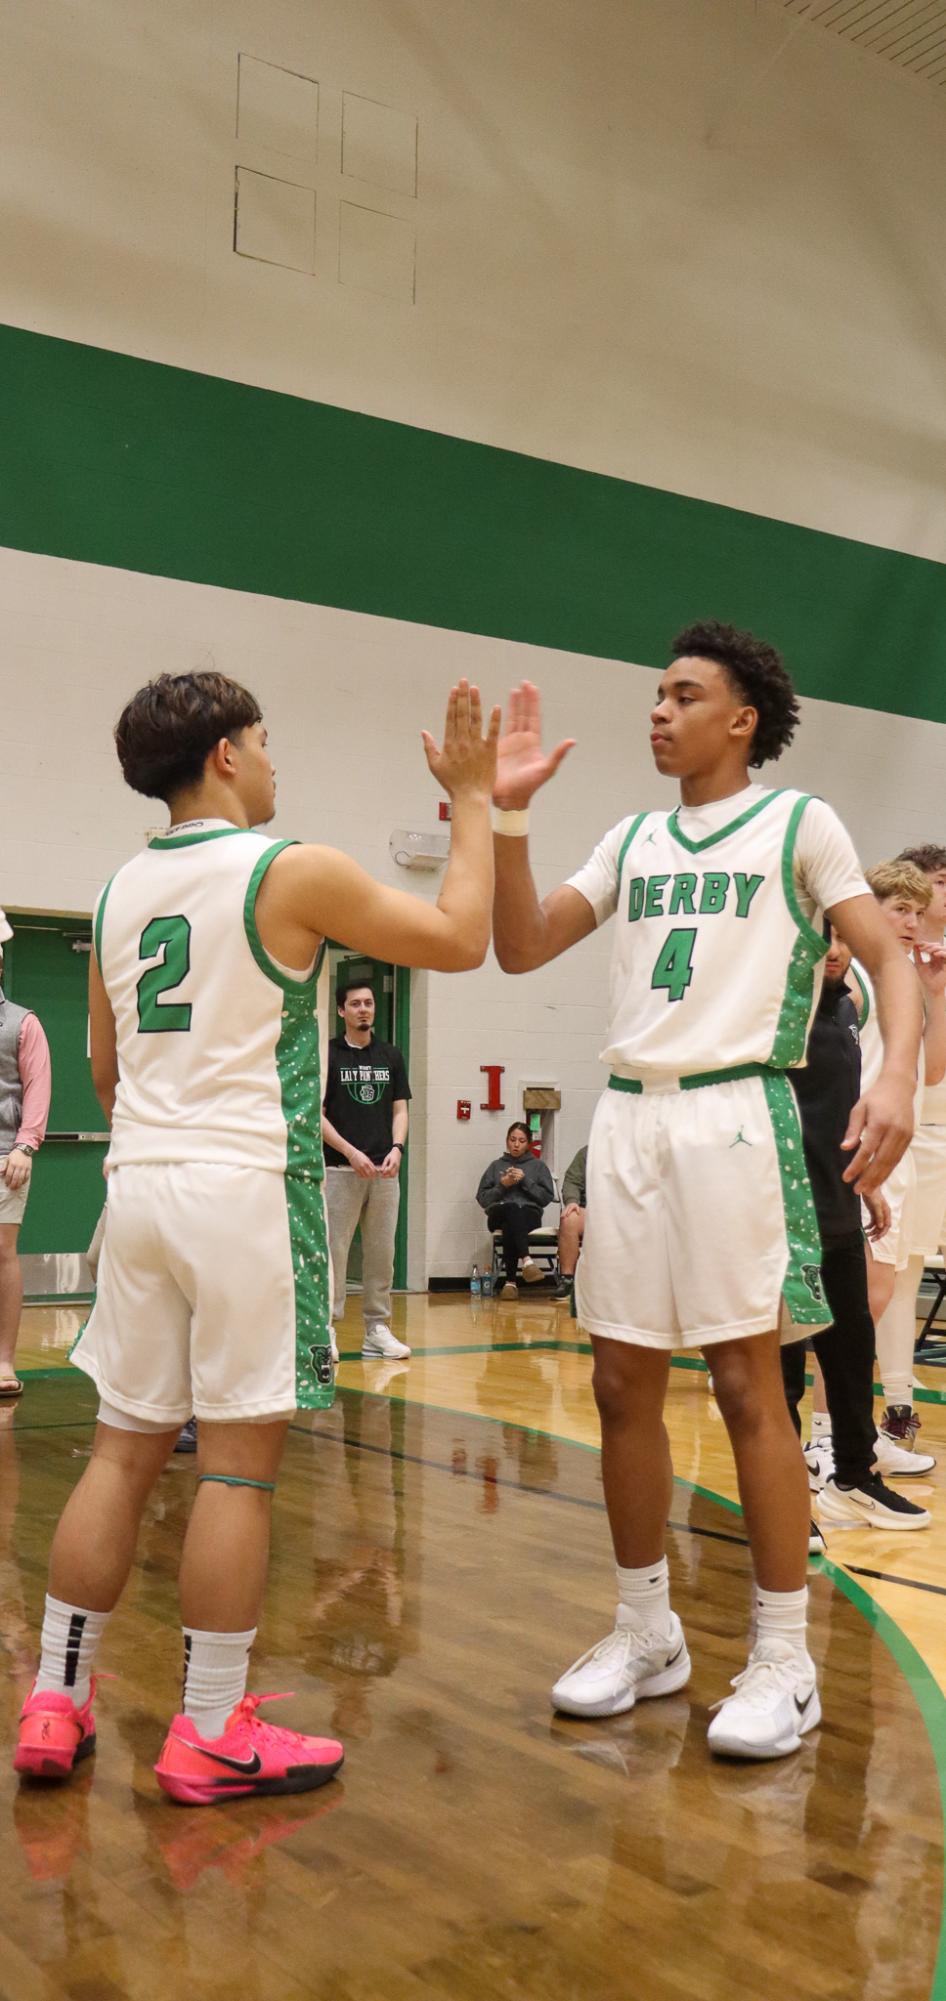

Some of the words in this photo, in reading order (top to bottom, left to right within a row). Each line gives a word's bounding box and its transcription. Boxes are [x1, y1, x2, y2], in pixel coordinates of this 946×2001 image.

[628, 872, 765, 922] DERBY
[136, 914, 192, 1033] 2
[651, 928, 698, 1002] 4
